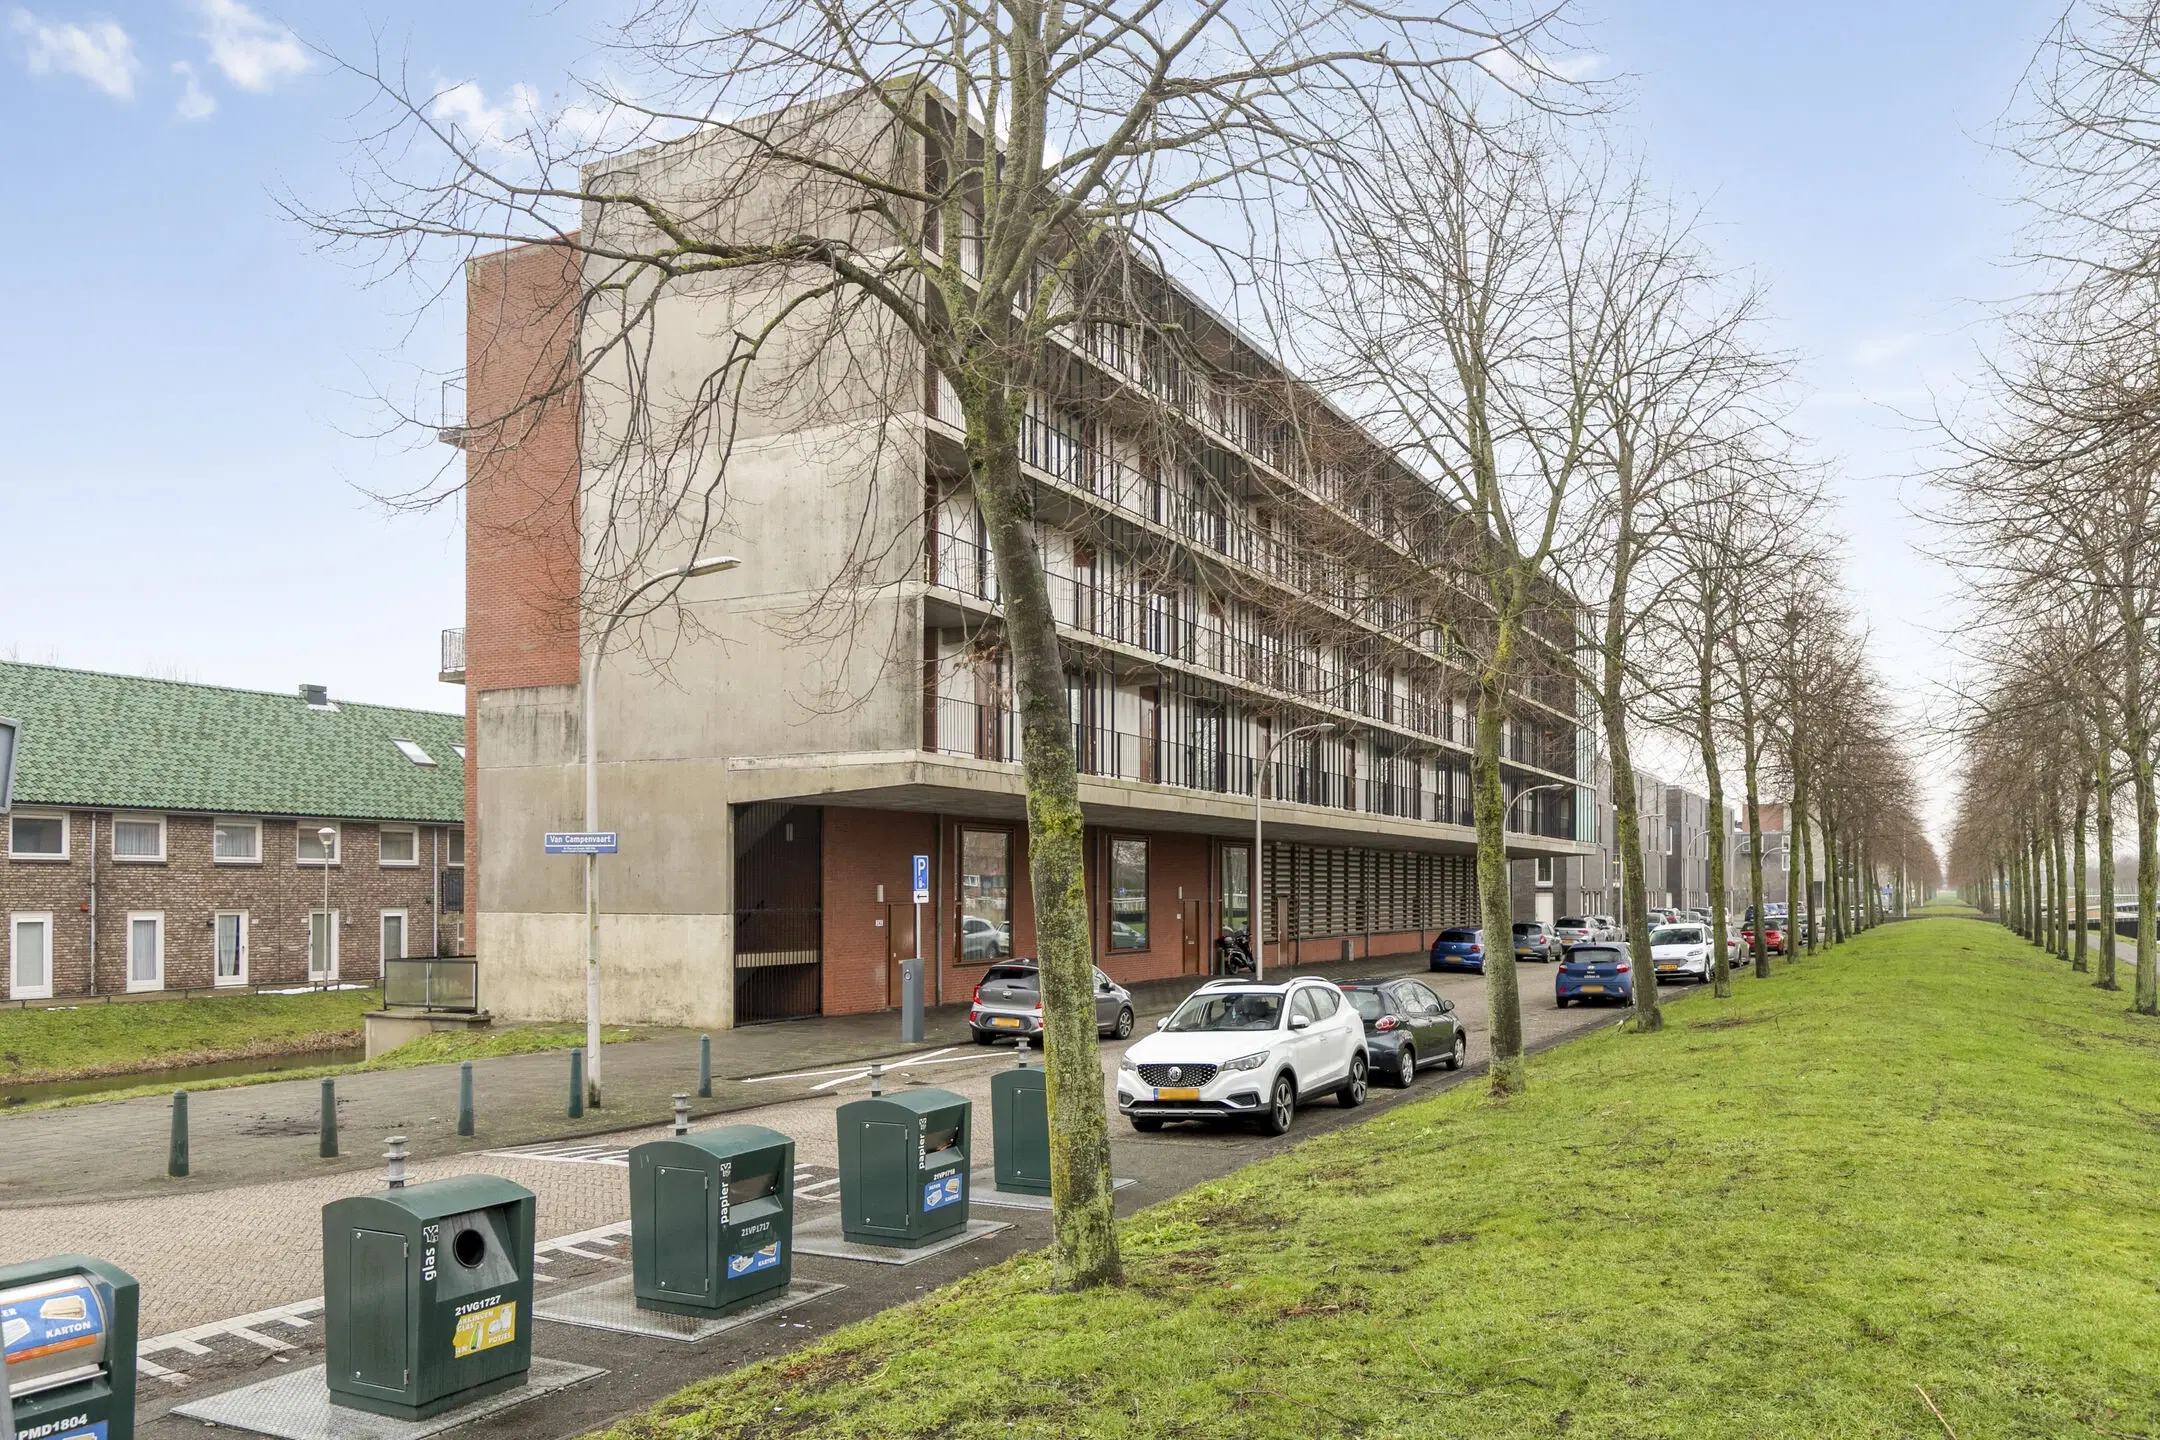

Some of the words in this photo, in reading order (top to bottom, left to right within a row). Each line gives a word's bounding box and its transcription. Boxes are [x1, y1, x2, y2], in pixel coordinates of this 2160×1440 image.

[550, 835, 562, 843] Van
[565, 835, 611, 845] Campenvaart
[917, 858, 926, 877] P
[918, 1134, 927, 1170] papier
[720, 1182, 730, 1225] papier
[741, 1222, 770, 1237] 21VP1717
[422, 1247, 437, 1281] glas
[455, 1295, 501, 1317] 21VG1727
[46, 1321, 91, 1339] KARTON
